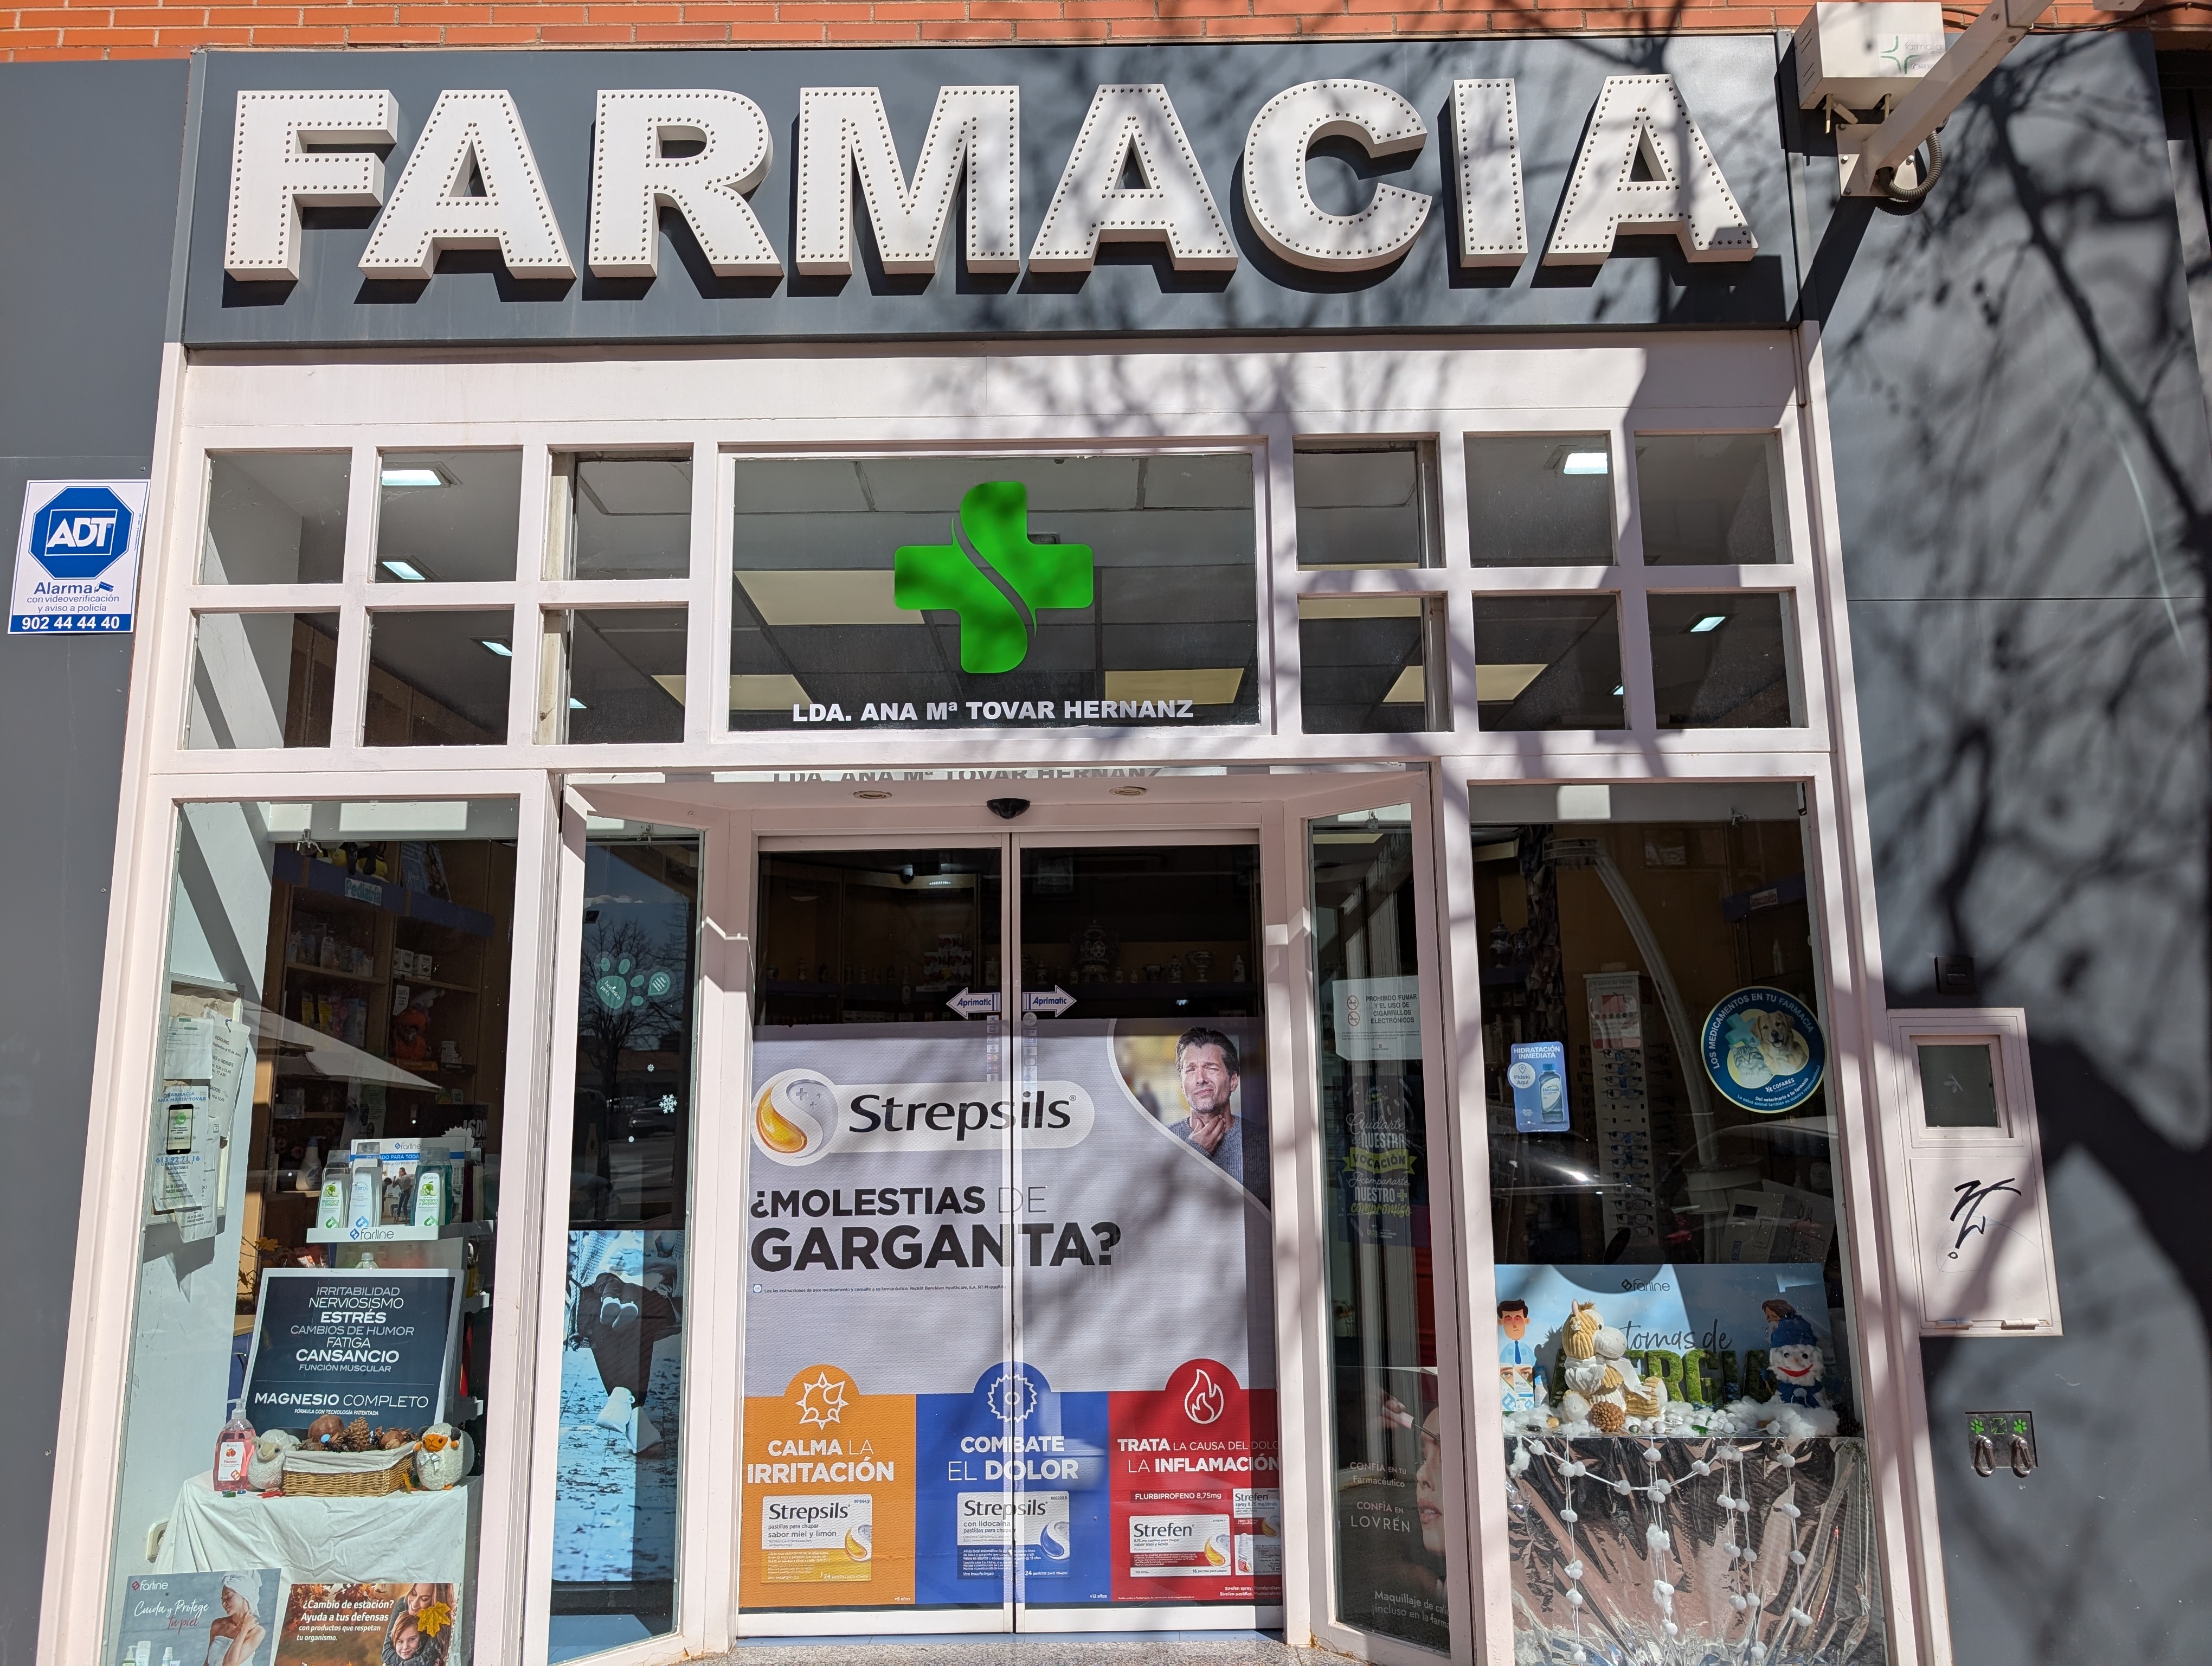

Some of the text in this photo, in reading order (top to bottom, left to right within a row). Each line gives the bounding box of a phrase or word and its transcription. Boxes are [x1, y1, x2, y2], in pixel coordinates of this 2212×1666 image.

[1905, 42, 1942, 50] farmalia
[224, 74, 1758, 281] FARMACIA
[47, 517, 115, 547] ADT
[34, 582, 92, 594] Alarma
[45, 594, 119, 603] videoverificación
[78, 603, 107, 613] policía
[22, 616, 120, 630] 902 44 44 40
[793, 700, 1194, 722] LDA. ANA Mª TOVAR HERNANZ
[956, 998, 992, 1008] Aprimatic
[1032, 996, 1067, 1007] Aprimatic
[1708, 993, 1814, 1069] LOS MEDICAMENTOS EN TU FARMACIA
[1514, 1045, 1560, 1054] HIDRATACIÓN
[1772, 1078, 1795, 1090] COFARES
[1764, 1094, 1787, 1103] veterinario
[849, 1091, 1071, 1141] Strepsils
[1346, 1112, 1405, 1135] Cuidarte
[1352, 1153, 1406, 1169] VOCACIÓN
[1355, 1187, 1396, 1203] NUESTRO
[750, 1186, 1047, 1219] ¿MOLESTIAS DE
[361, 1228, 395, 1240] farline
[751, 1221, 1121, 1272] GARGANTA?
[316, 1286, 400, 1296] IRRITABILIDAD
[1633, 1278, 1670, 1292] farline
[308, 1297, 404, 1309] NERVIOSISMO
[320, 1309, 387, 1324] ESTRÉS
[290, 1325, 415, 1336] CAMBIOS DE HUMOR
[1619, 1318, 1732, 1353] tomas de
[326, 1337, 371, 1349] FATIGA
[295, 1349, 400, 1363] CANSANCIO
[299, 1363, 391, 1373] FUNCIÓN MUSCULAR
[254, 1392, 429, 1408] MAGNESIO COMPLETO
[768, 1439, 874, 1456] CALMA LA
[960, 1436, 1064, 1453] COMBATE
[1117, 1438, 1278, 1452] TRATA LA CAUSA DEL DOLO
[747, 1456, 894, 1484] IRRITACIÓN
[948, 1459, 1079, 1481] EL DOLOR
[1128, 1453, 1279, 1473] LA INFLAMACIÓN
[1350, 1461, 1386, 1472] CONFÍA
[1353, 1475, 1405, 1488] Farmacéutico
[1197, 1492, 1222, 1501] 8,75mg
[1234, 1492, 1269, 1501] Strefen
[769, 1502, 848, 1523] Strepsils
[964, 1500, 1046, 1520] Strepsils
[1356, 1501, 1392, 1513] CONFÍA
[1134, 1522, 1192, 1537] Strefen
[140, 1580, 169, 1591] farline
[134, 1599, 209, 1619] Cuida Protege
[303, 1600, 394, 1609] ¿Cambio de estación?
[1374, 1591, 1449, 1616] Maquillaje de cali
[300, 1612, 389, 1624] Ayuda tus defensas
[1372, 1604, 1449, 1629] ¡incluso en la farma
[168, 1614, 199, 1634] tu piel
[310, 1624, 341, 1632] productos
[304, 1634, 338, 1643] organismo.
